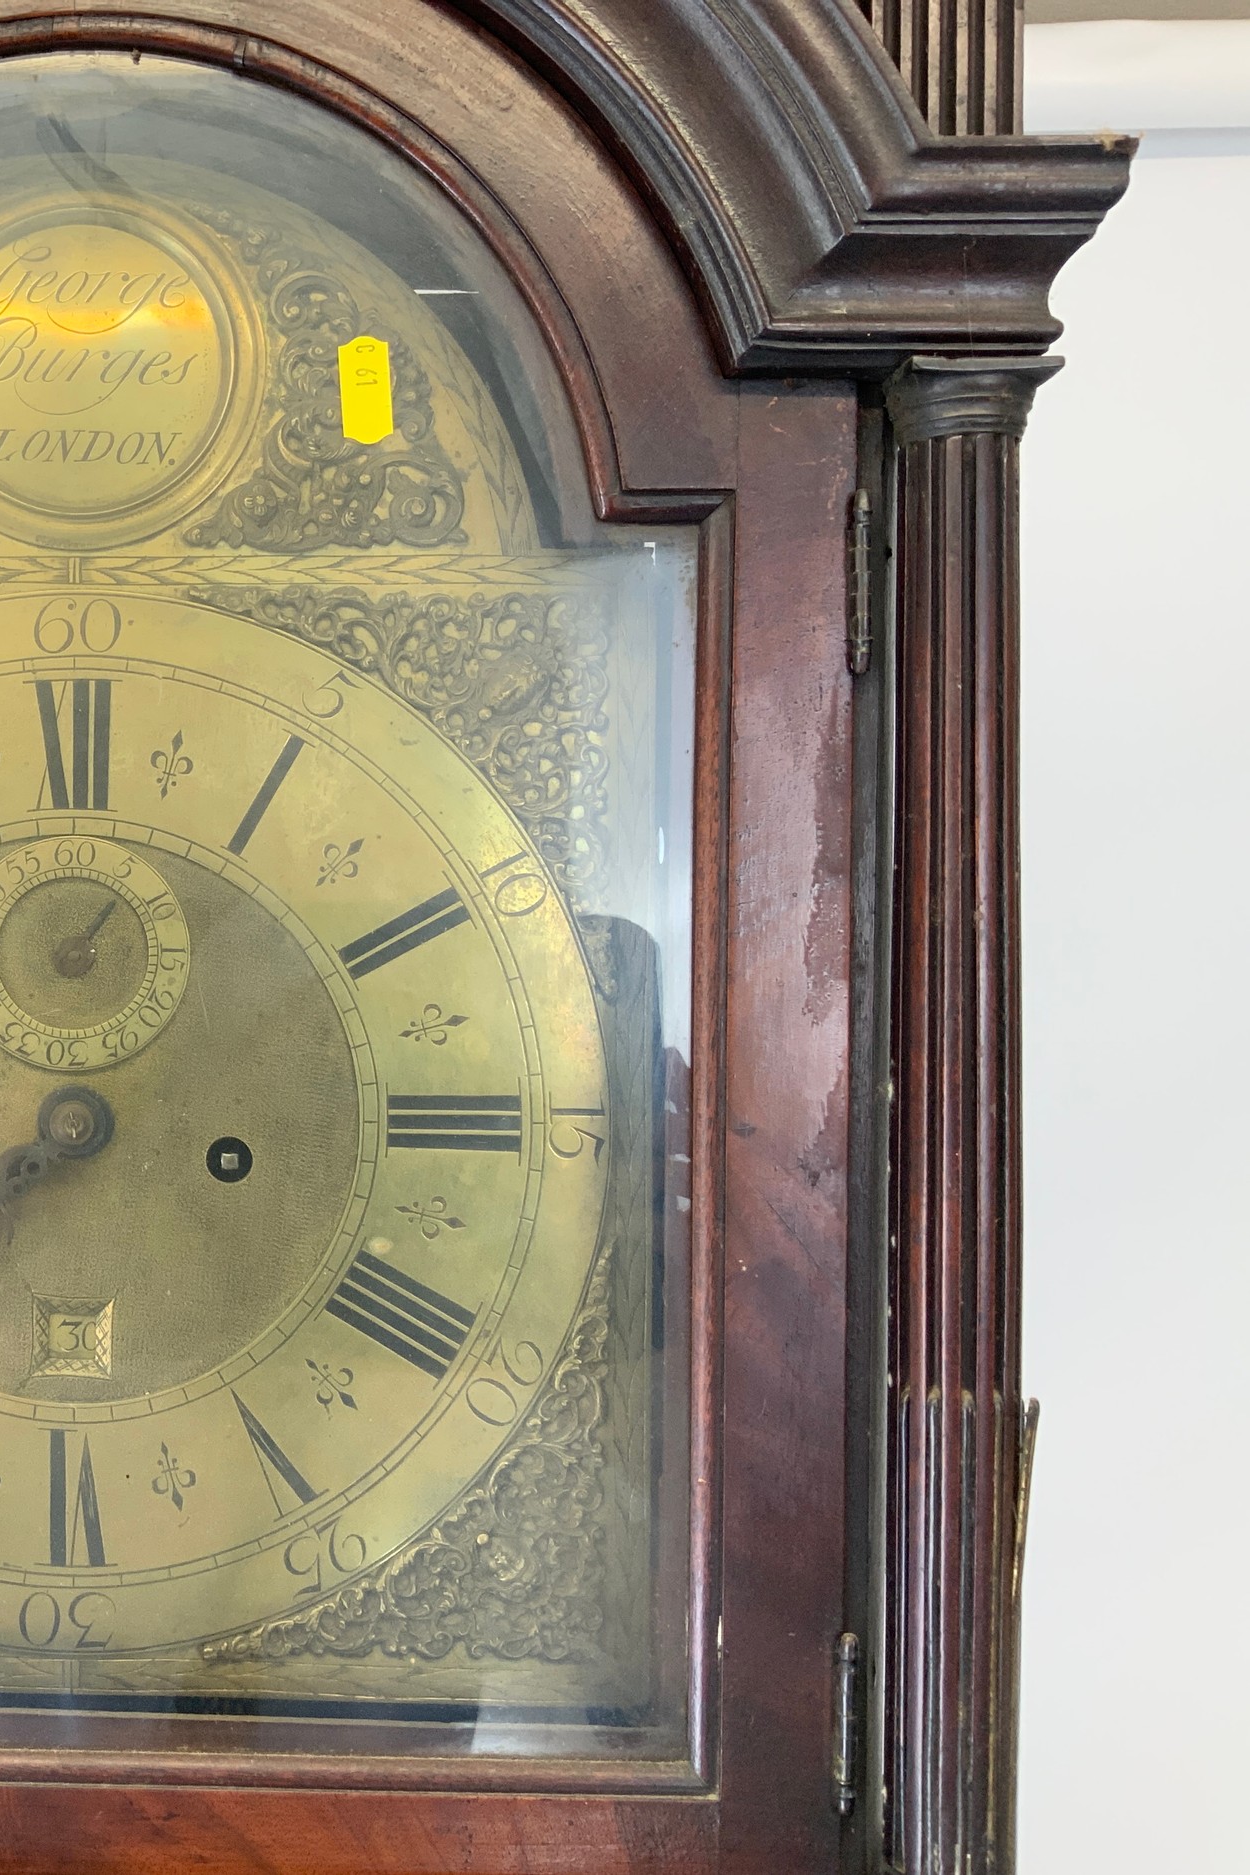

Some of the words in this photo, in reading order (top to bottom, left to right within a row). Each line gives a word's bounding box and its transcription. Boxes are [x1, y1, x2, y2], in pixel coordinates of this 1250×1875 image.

[355, 344, 376, 354] C
[355, 367, 379, 386] 61
[34, 598, 121, 654] 60
[302, 670, 363, 719] 5
[23, 678, 117, 812] XII
[221, 729, 316, 862] I
[5, 851, 40, 884] 55
[54, 839, 96, 867] 60
[112, 856, 139, 879] 5
[468, 839, 548, 917] 10
[142, 890, 176, 921] 10
[331, 869, 478, 991] II
[160, 943, 187, 972] 15
[138, 987, 174, 1028] 20
[46, 1039, 89, 1067] 30
[102, 1025, 138, 1058] 25
[386, 1076, 521, 1167] III
[549, 1091, 605, 1167] 15
[57, 1319, 96, 1351] 30
[314, 1237, 482, 1390] IIII
[465, 1337, 544, 1427] 20
[229, 1387, 330, 1518] V
[34, 1428, 118, 1567] VI
[283, 1514, 367, 1599] 25
[18, 1592, 116, 1650] 30
